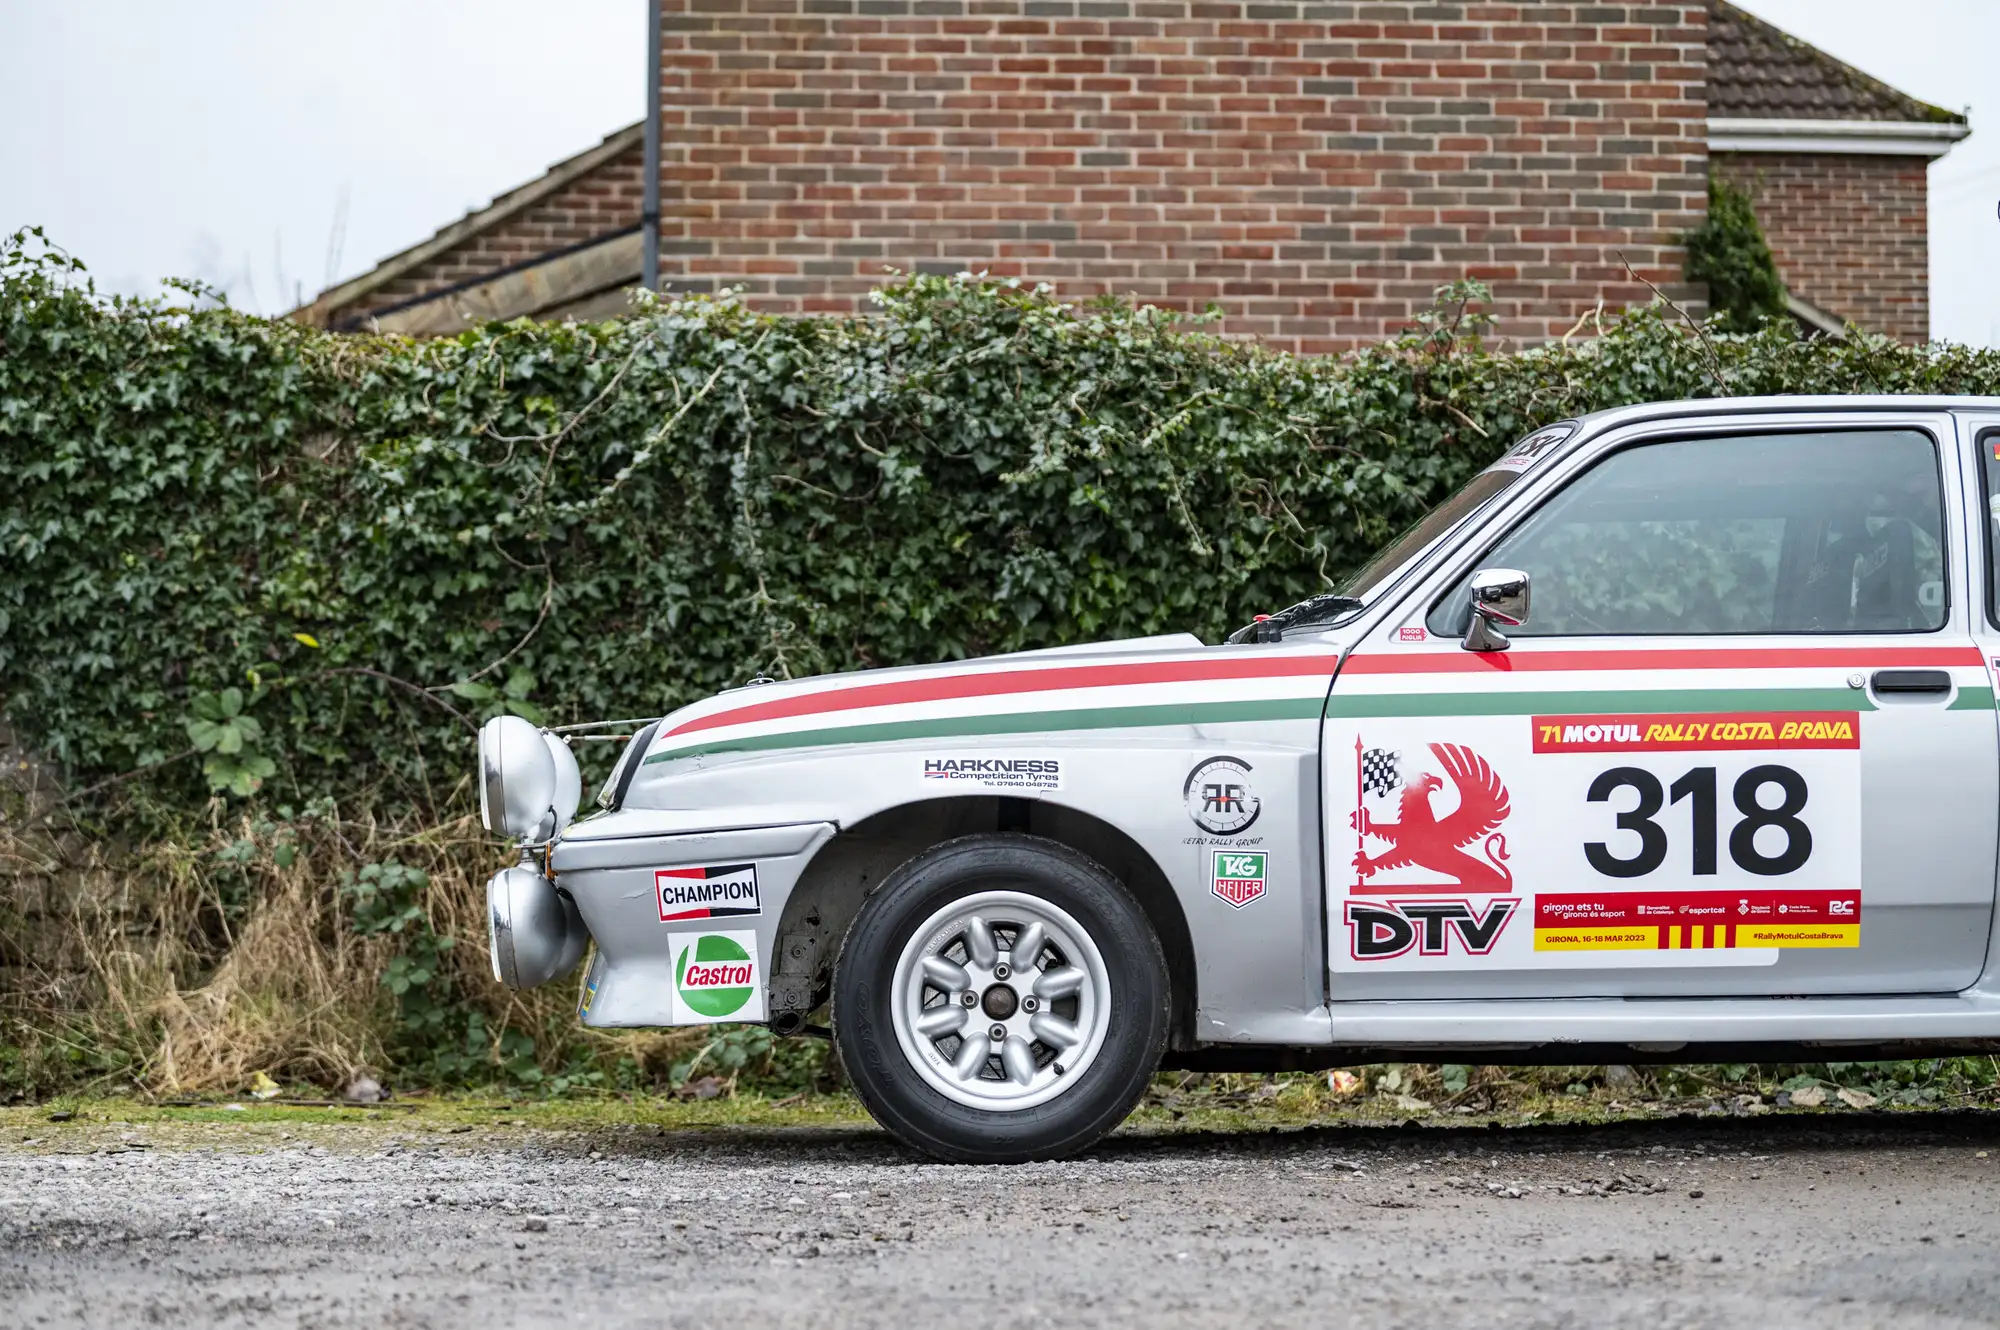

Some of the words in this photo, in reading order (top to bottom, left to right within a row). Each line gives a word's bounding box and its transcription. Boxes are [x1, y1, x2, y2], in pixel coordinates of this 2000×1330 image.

[1644, 723, 1709, 742] RALLY
[1711, 722, 1775, 741] COSTA
[1778, 721, 1853, 740] BRAVA
[924, 759, 1059, 773] HARKNESS
[949, 772, 1023, 780] Competition
[1025, 772, 1059, 782] Tyres
[1583, 764, 1813, 879] 318
[1209, 837, 1234, 846] RALLY
[1236, 837, 1263, 848] GROUP
[1223, 856, 1257, 876] TAG
[662, 881, 754, 905] CHAMPION
[1217, 881, 1260, 902] HEUER
[1542, 903, 1574, 914] girona
[1577, 902, 1591, 911] ets
[1594, 902, 1604, 911] tu
[1563, 911, 1588, 919] girona
[1600, 910, 1625, 918] esport
[1688, 907, 1726, 915] esportcat
[1345, 899, 1521, 960] DTV
[1753, 932, 1843, 940] #RallyMotulCostaBrava
[1624, 934, 1645, 942] 2023
[686, 963, 753, 987] Castrol
